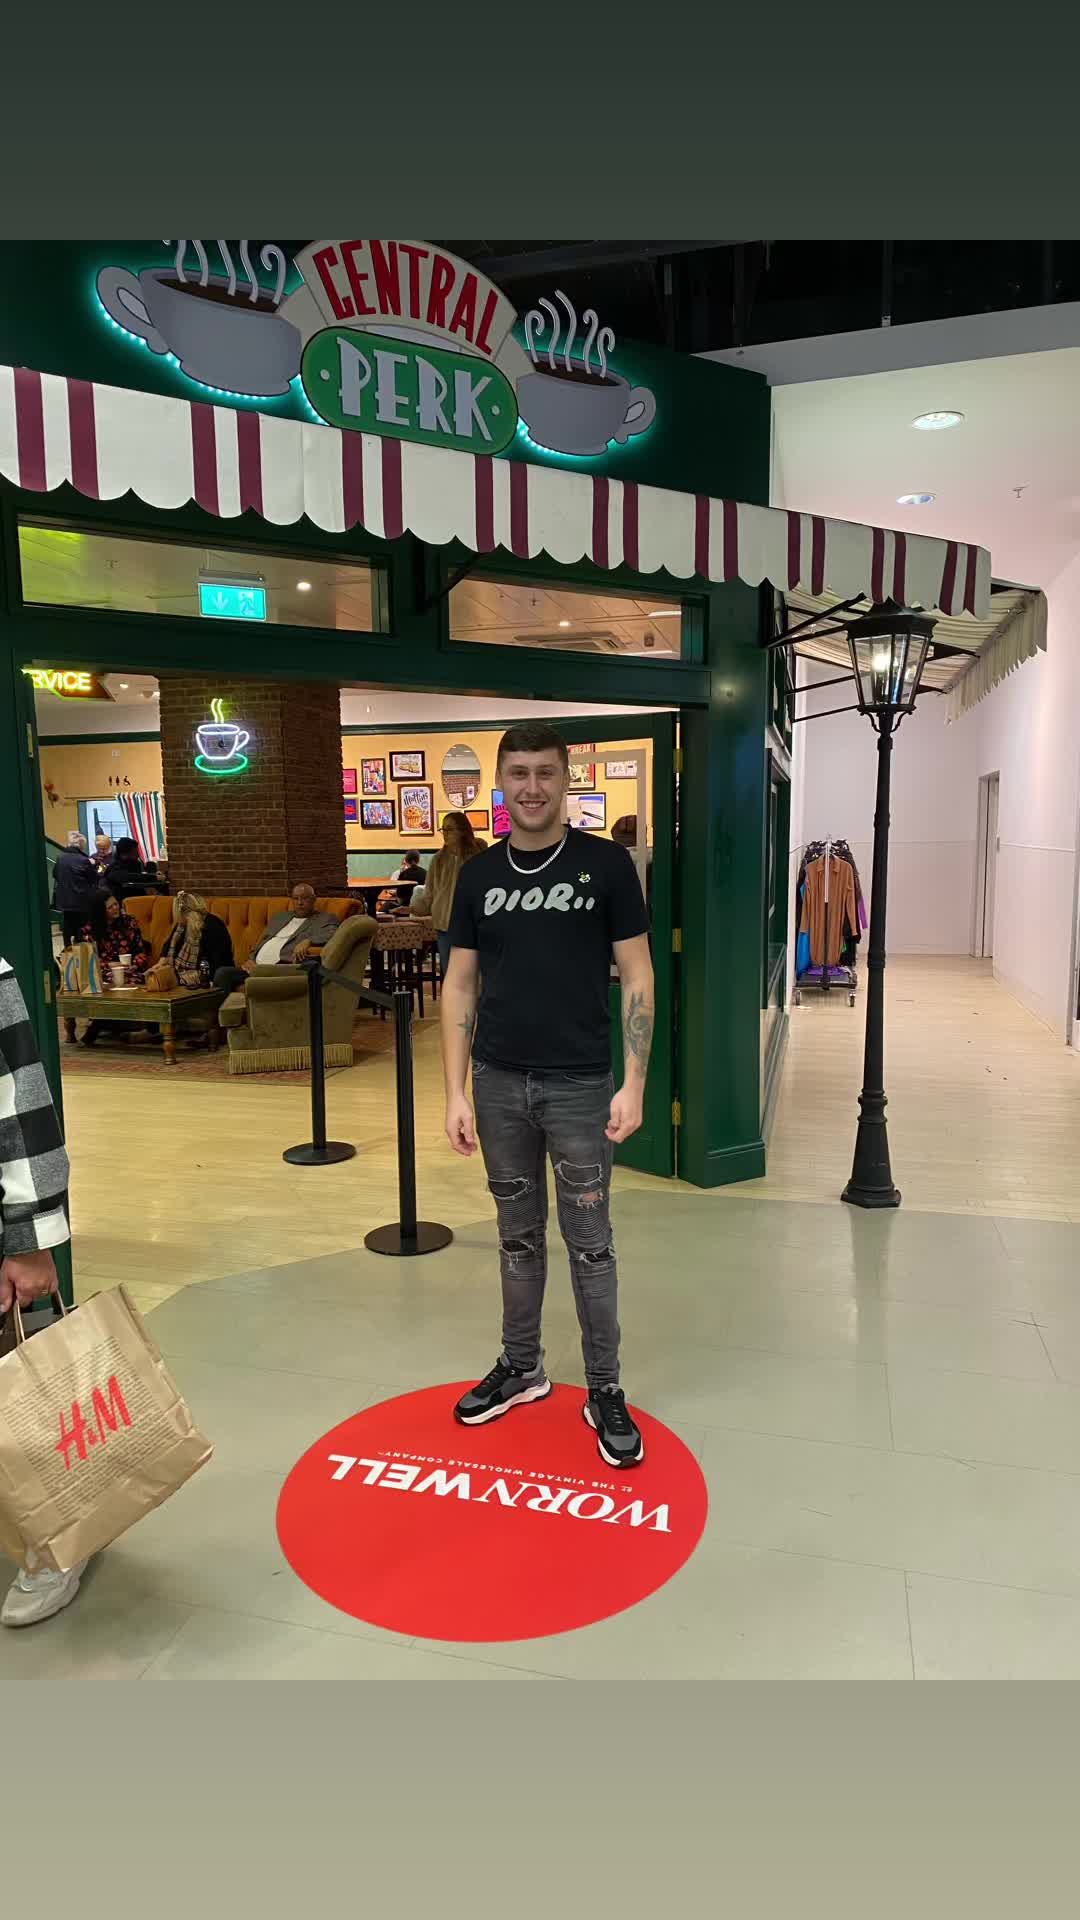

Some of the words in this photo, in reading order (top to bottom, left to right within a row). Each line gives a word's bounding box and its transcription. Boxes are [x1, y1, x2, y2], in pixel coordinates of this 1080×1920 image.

[312, 240, 499, 356] CENTRAL
[336, 336, 493, 441] PERK
[55, 1374, 133, 1472] H&M
[448, 1459, 523, 1476] WHOLESALE
[529, 1471, 585, 1485] VINTAGE
[592, 1481, 616, 1490] THE
